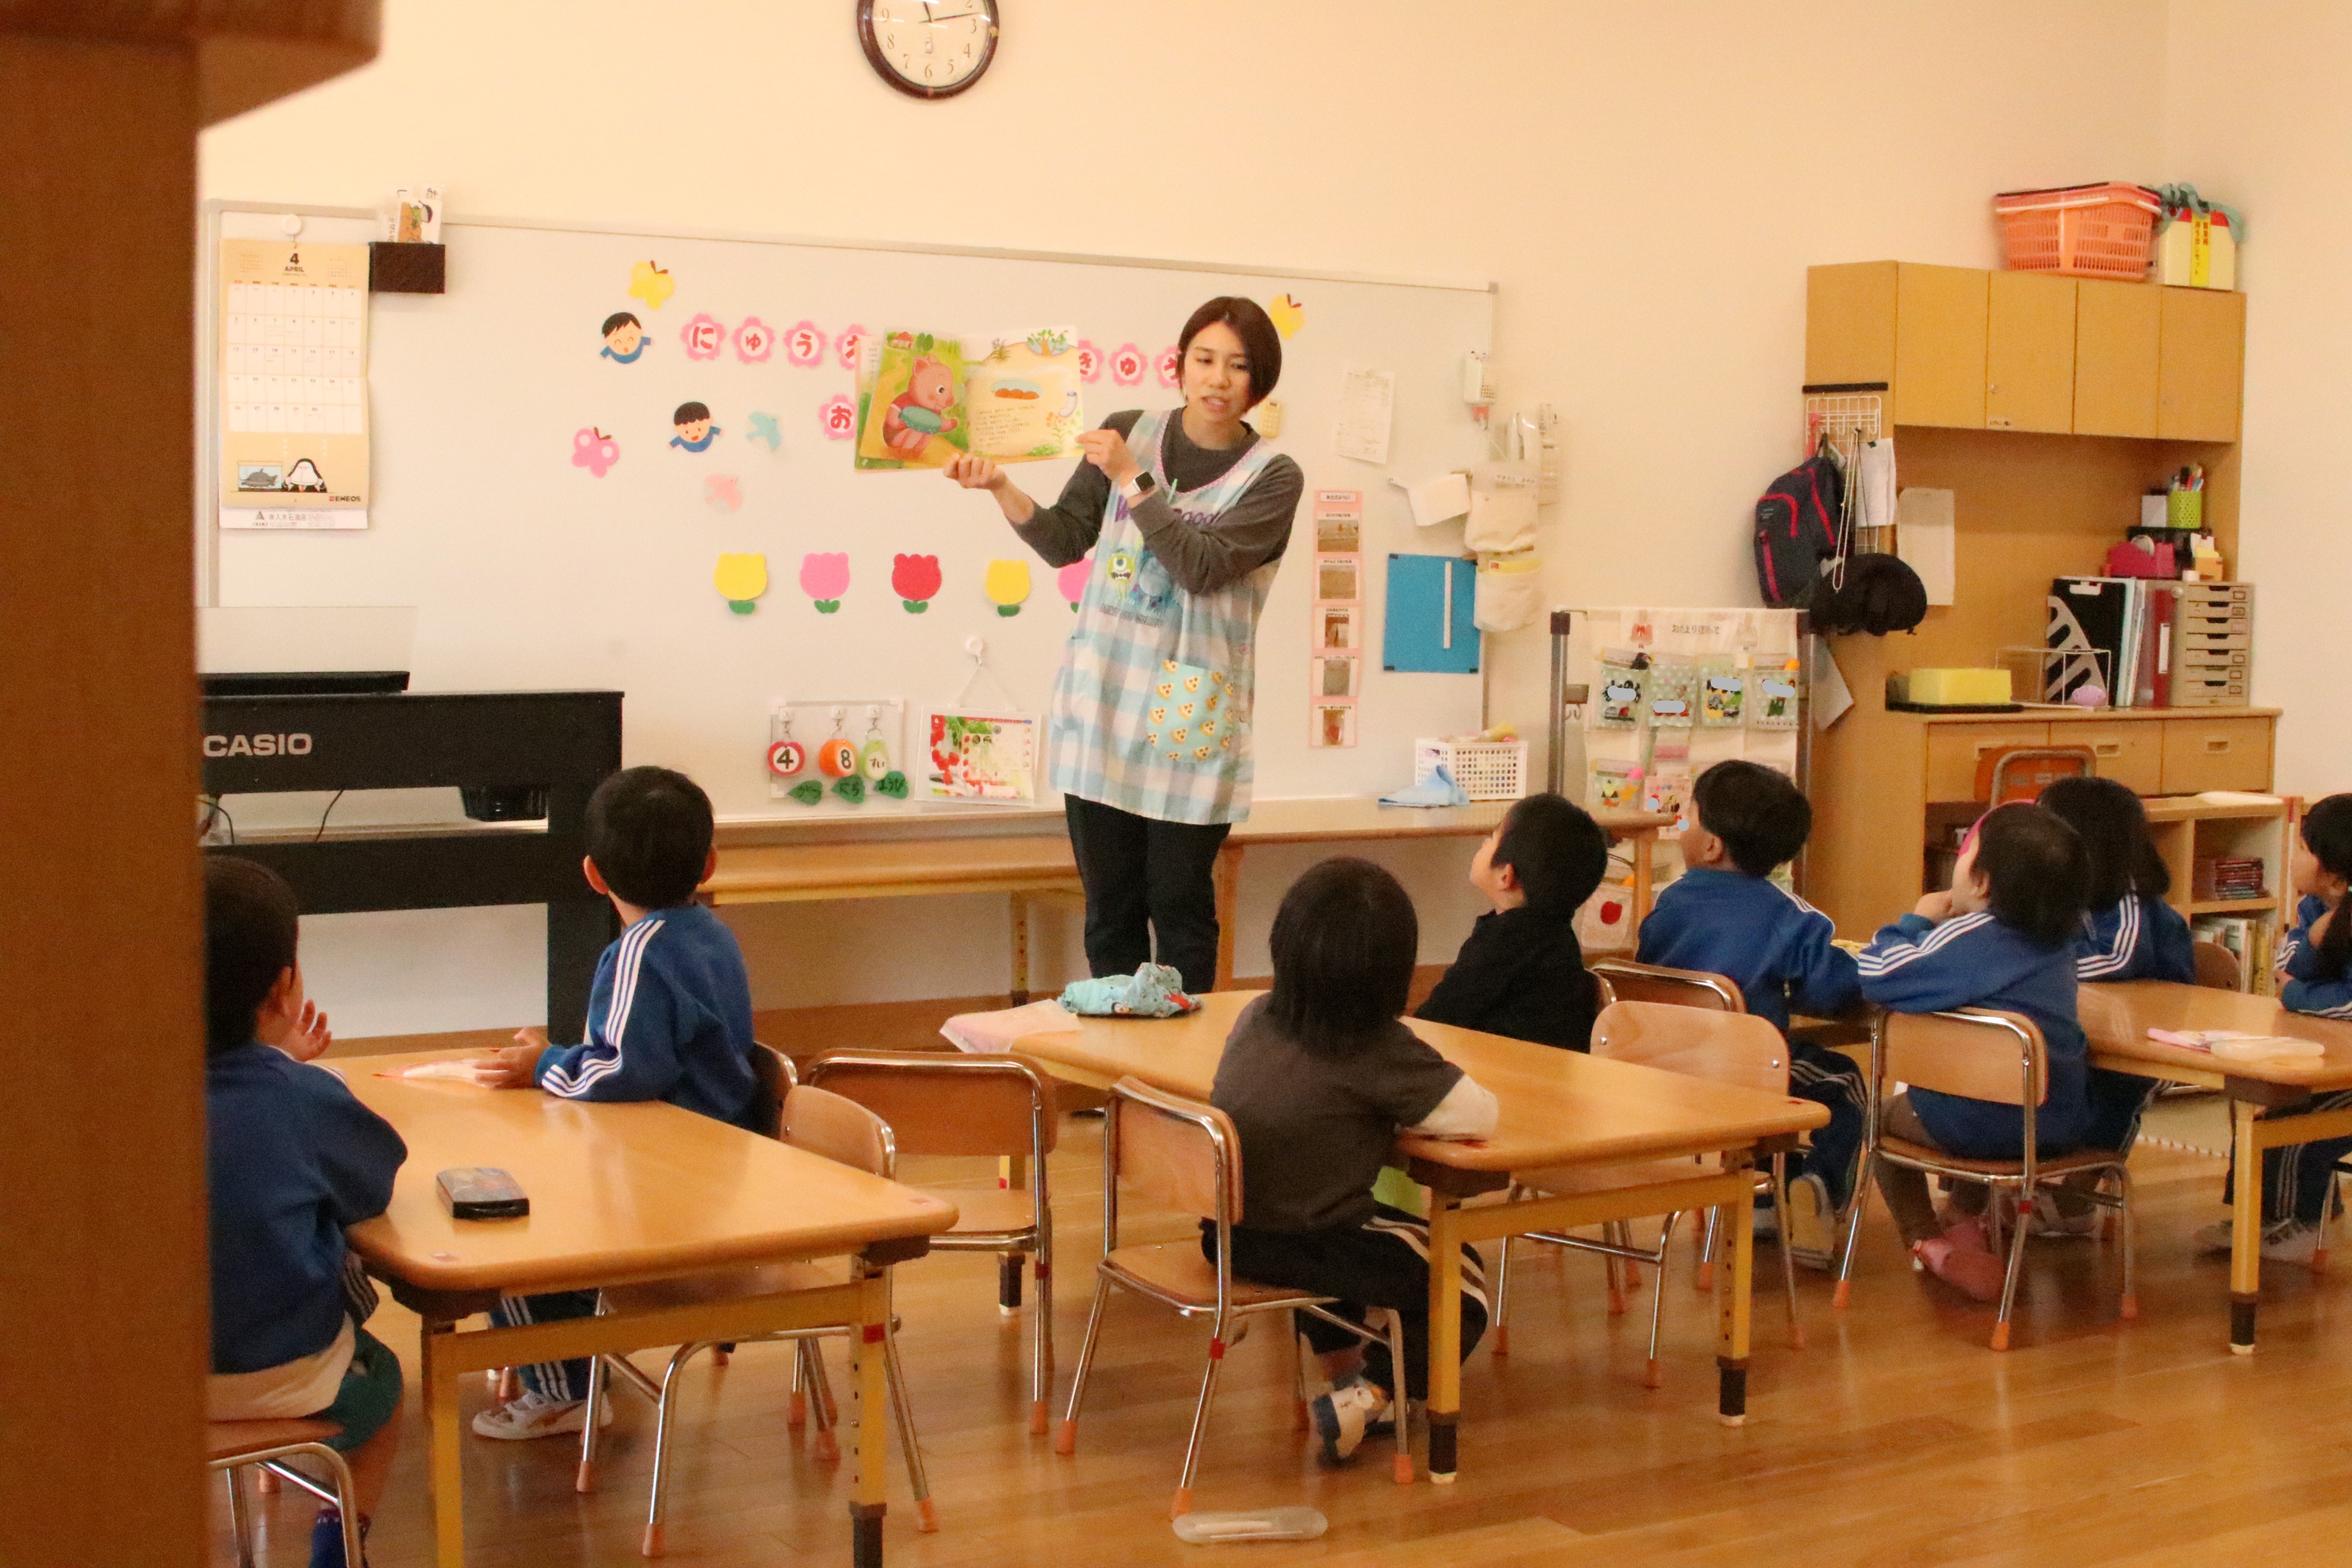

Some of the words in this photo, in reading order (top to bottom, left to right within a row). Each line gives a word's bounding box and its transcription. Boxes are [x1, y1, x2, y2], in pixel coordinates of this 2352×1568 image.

[882, 8, 889, 23] 9
[970, 18, 977, 34] 3
[887, 34, 895, 50] 8
[963, 43, 971, 58] 4
[903, 53, 911, 69] 7
[947, 59, 954, 75] 5
[924, 63, 933, 78] 6
[290, 253, 299, 265] 4
[830, 405, 853, 430] お
[202, 733, 312, 758] CASIO
[776, 748, 794, 769] 4
[840, 749, 853, 769] 8
